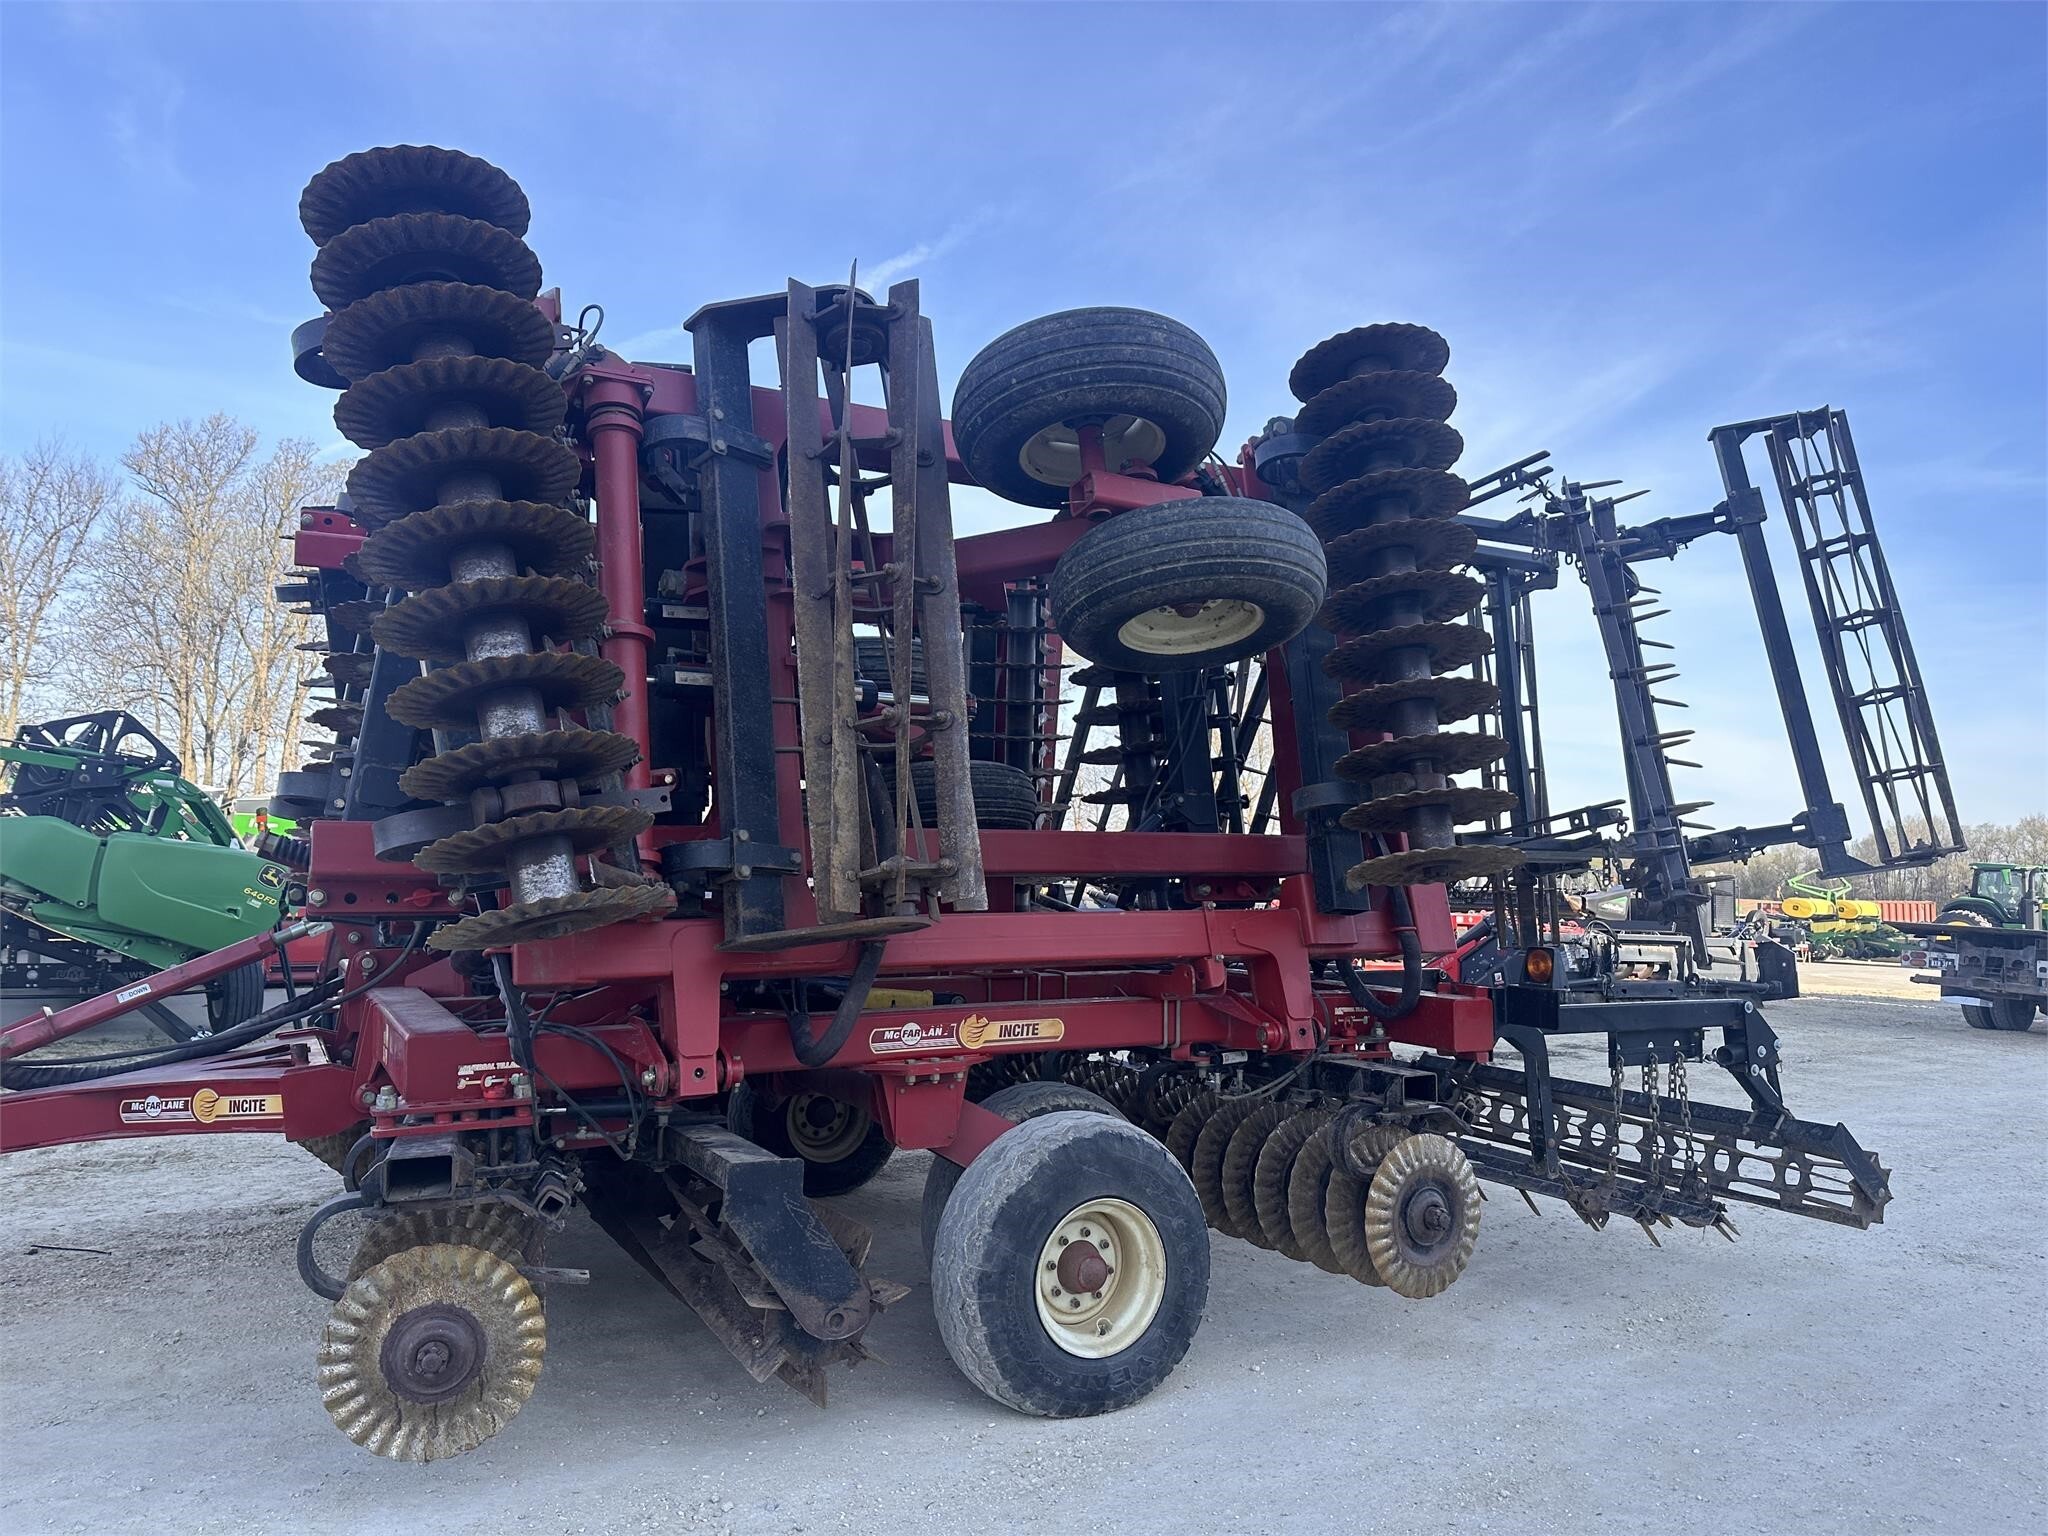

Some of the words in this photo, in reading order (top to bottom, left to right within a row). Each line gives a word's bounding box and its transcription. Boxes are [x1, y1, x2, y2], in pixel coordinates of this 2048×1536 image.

[243, 887, 277, 905] 640FD
[128, 986, 149, 998] DOWN
[999, 1022, 1040, 1038] INCITE
[131, 1096, 185, 1117] McFARLANE
[229, 1099, 266, 1113] INCITE
